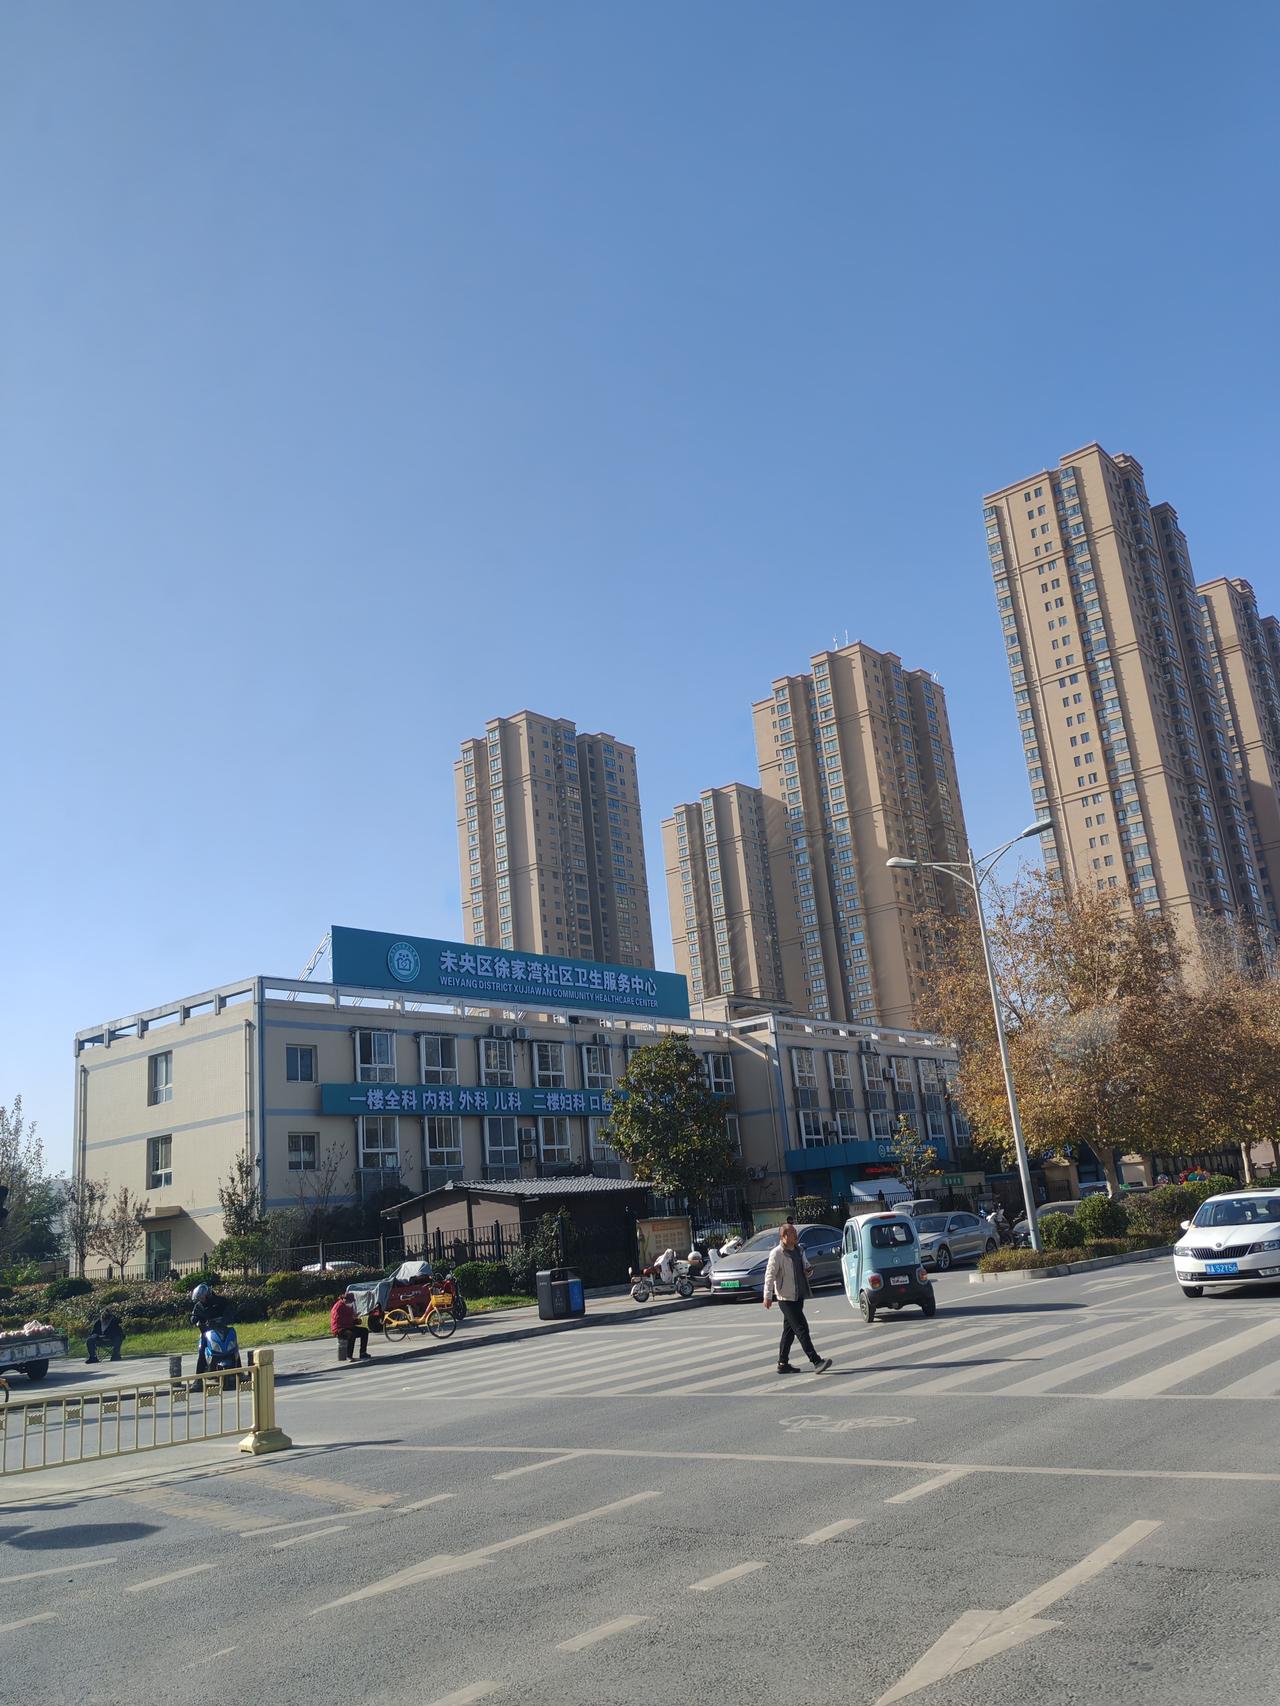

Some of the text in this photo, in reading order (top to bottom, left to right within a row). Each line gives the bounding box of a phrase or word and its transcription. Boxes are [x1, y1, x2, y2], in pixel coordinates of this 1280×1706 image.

[440, 950, 657, 996] 未央区徐家湾社区卫生服务中心
[440, 976, 658, 1008] WEIYANG DISTRICT XUJIAWAN COMMUNITY HEALTHCARE CENTER
[350, 1089, 417, 1110] 一楼全科
[422, 1090, 453, 1111] 内科
[459, 1091, 489, 1111] 外科
[494, 1092, 522, 1112] 儿科
[533, 1093, 586, 1112] 二楼妇科
